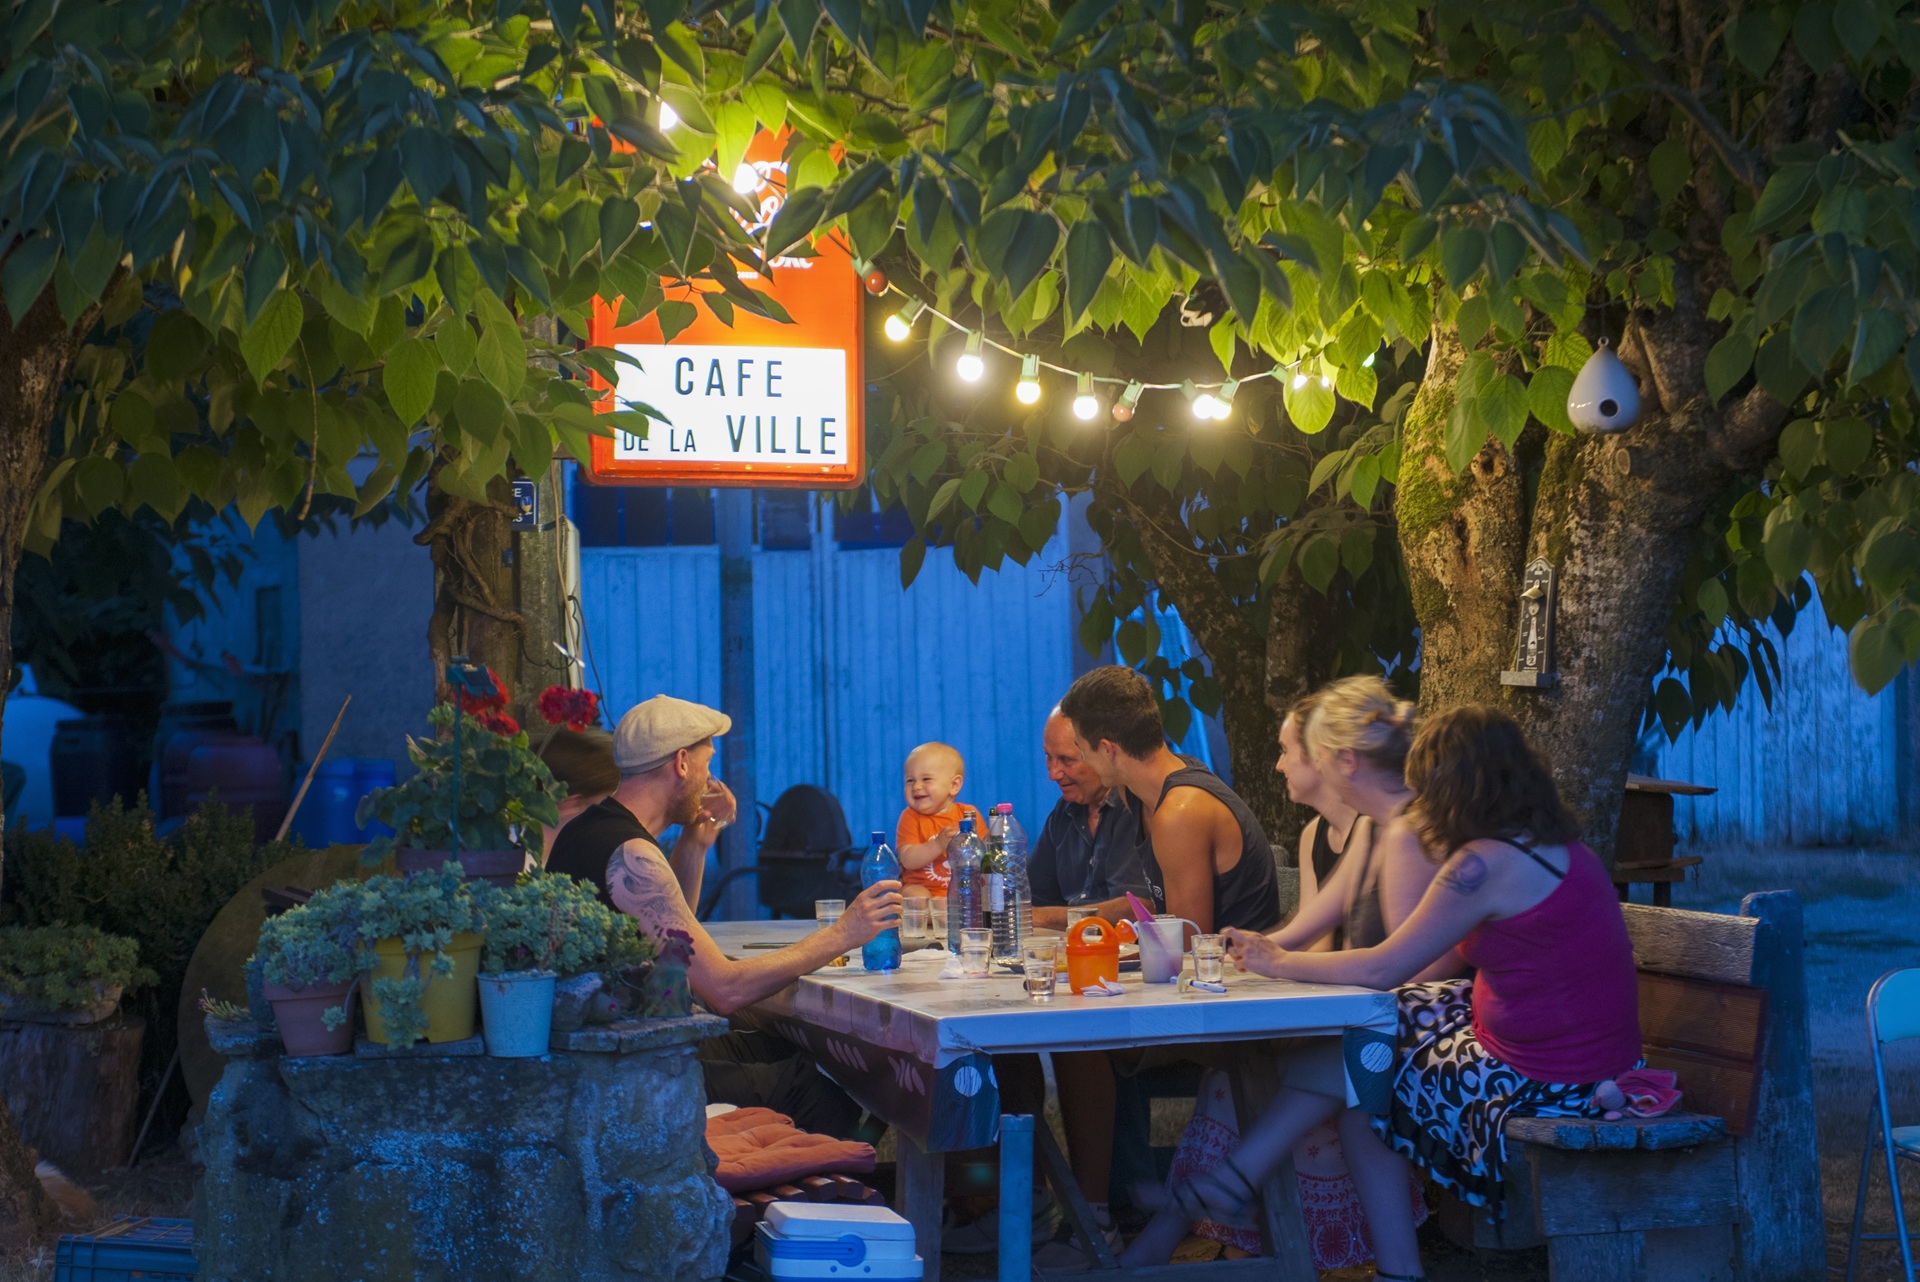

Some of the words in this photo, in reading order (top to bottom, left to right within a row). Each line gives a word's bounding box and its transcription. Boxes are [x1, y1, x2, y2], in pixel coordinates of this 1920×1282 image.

[675, 357, 783, 397] CAFE
[670, 429, 697, 452] LA
[726, 415, 836, 455] VILLE
